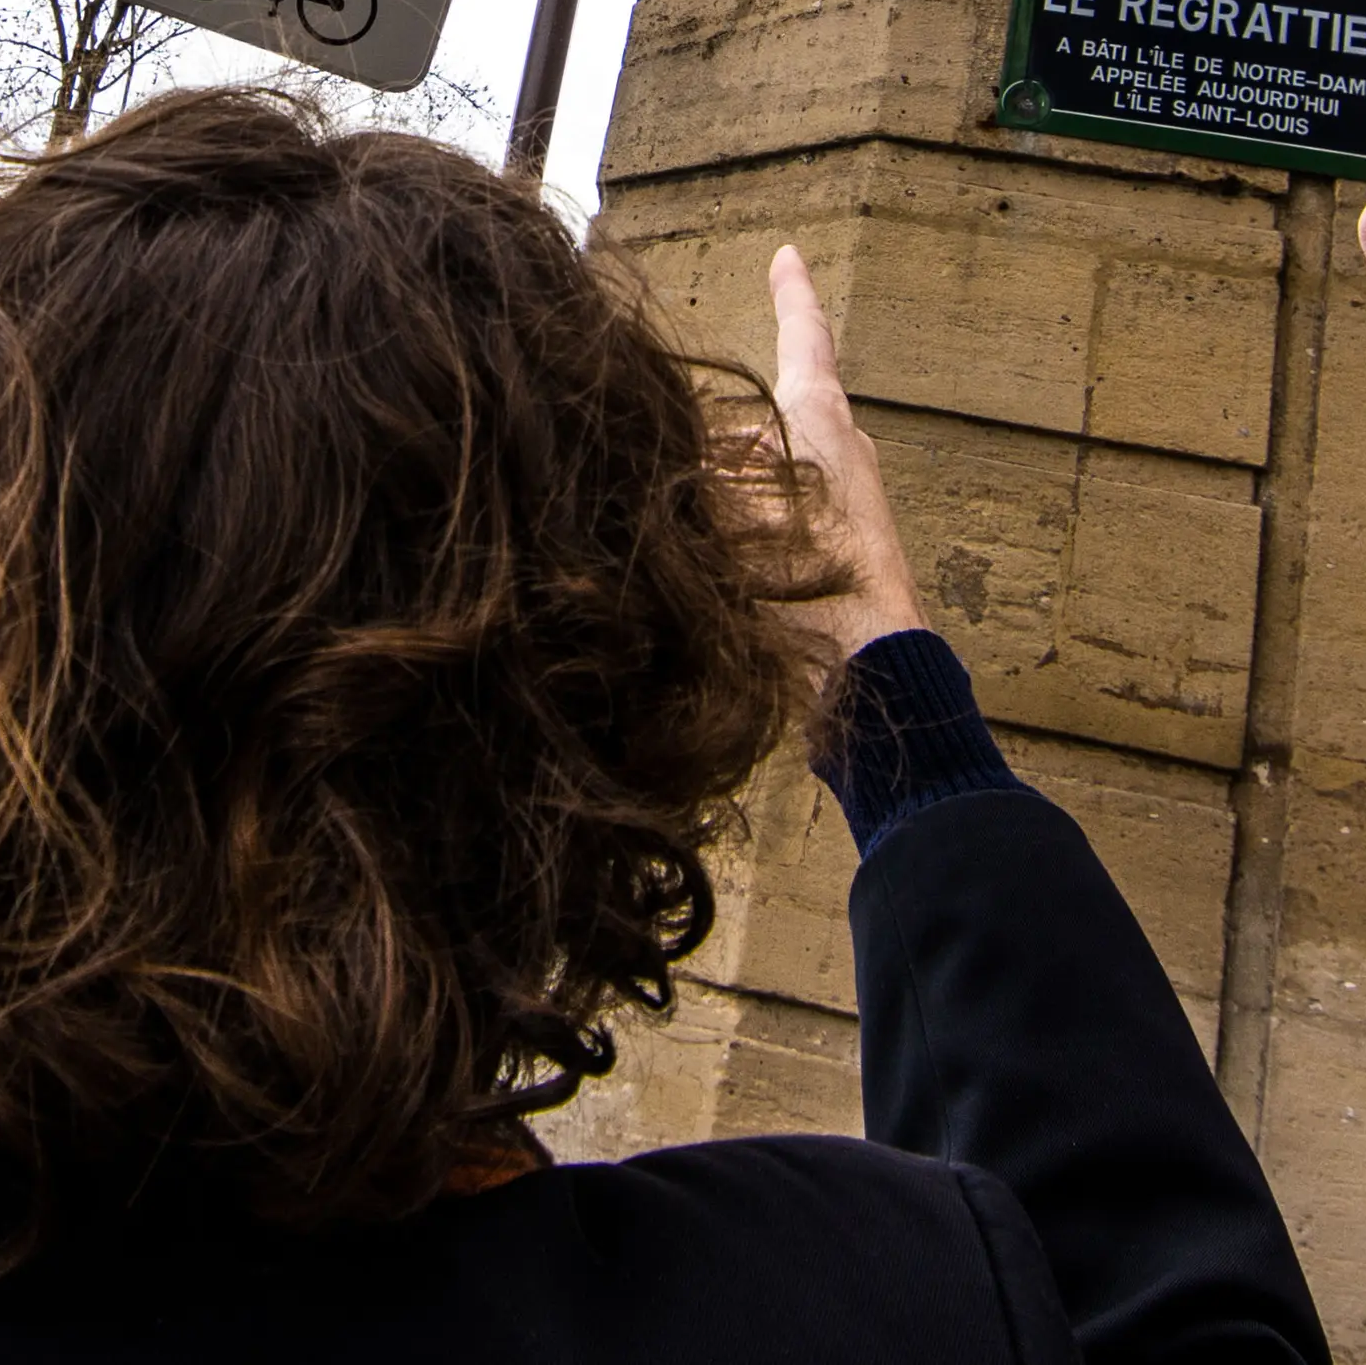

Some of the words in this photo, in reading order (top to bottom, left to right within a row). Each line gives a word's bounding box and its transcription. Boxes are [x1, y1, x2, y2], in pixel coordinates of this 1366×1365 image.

[1056, 37, 1071, 54] A
[1081, 38, 1128, 62] BÂTI
[1136, 45, 1185, 70] L'ÎLE
[1194, 55, 1223, 76] DE
[1090, 64, 1186, 95] APPELÉE
[1197, 79, 1340, 117] AUJOURD'HUI
[1113, 88, 1162, 114] L'ÎLE
[1172, 99, 1311, 136] SAINT-LOUIS
